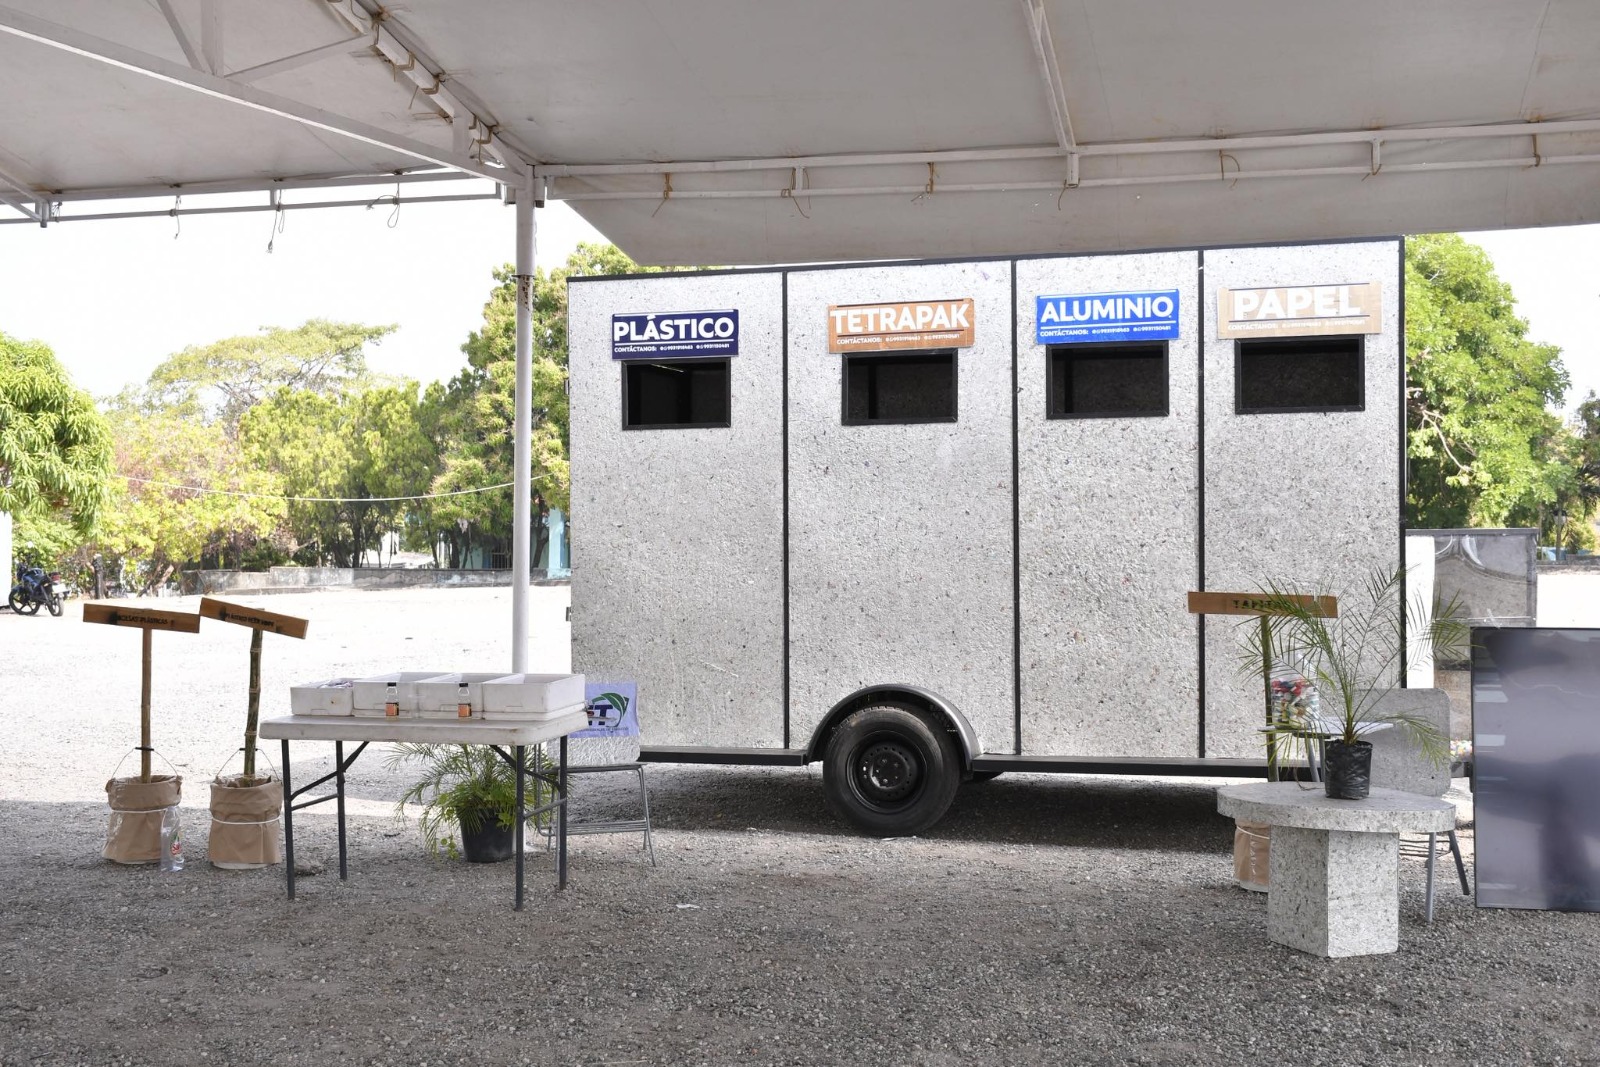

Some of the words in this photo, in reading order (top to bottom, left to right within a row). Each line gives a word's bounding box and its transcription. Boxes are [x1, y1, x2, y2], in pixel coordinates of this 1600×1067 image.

[1041, 296, 1173, 322] ALUMINIO
[1233, 286, 1360, 320] PAPEL
[613, 315, 735, 342] PLÁSTICO
[830, 303, 970, 333] TETRAPAK
[837, 336, 882, 345] CONTÁCTANOS:
[1040, 328, 1089, 337] CONTÁCTANOS:
[614, 344, 658, 353] CONTÁCTANOS:
